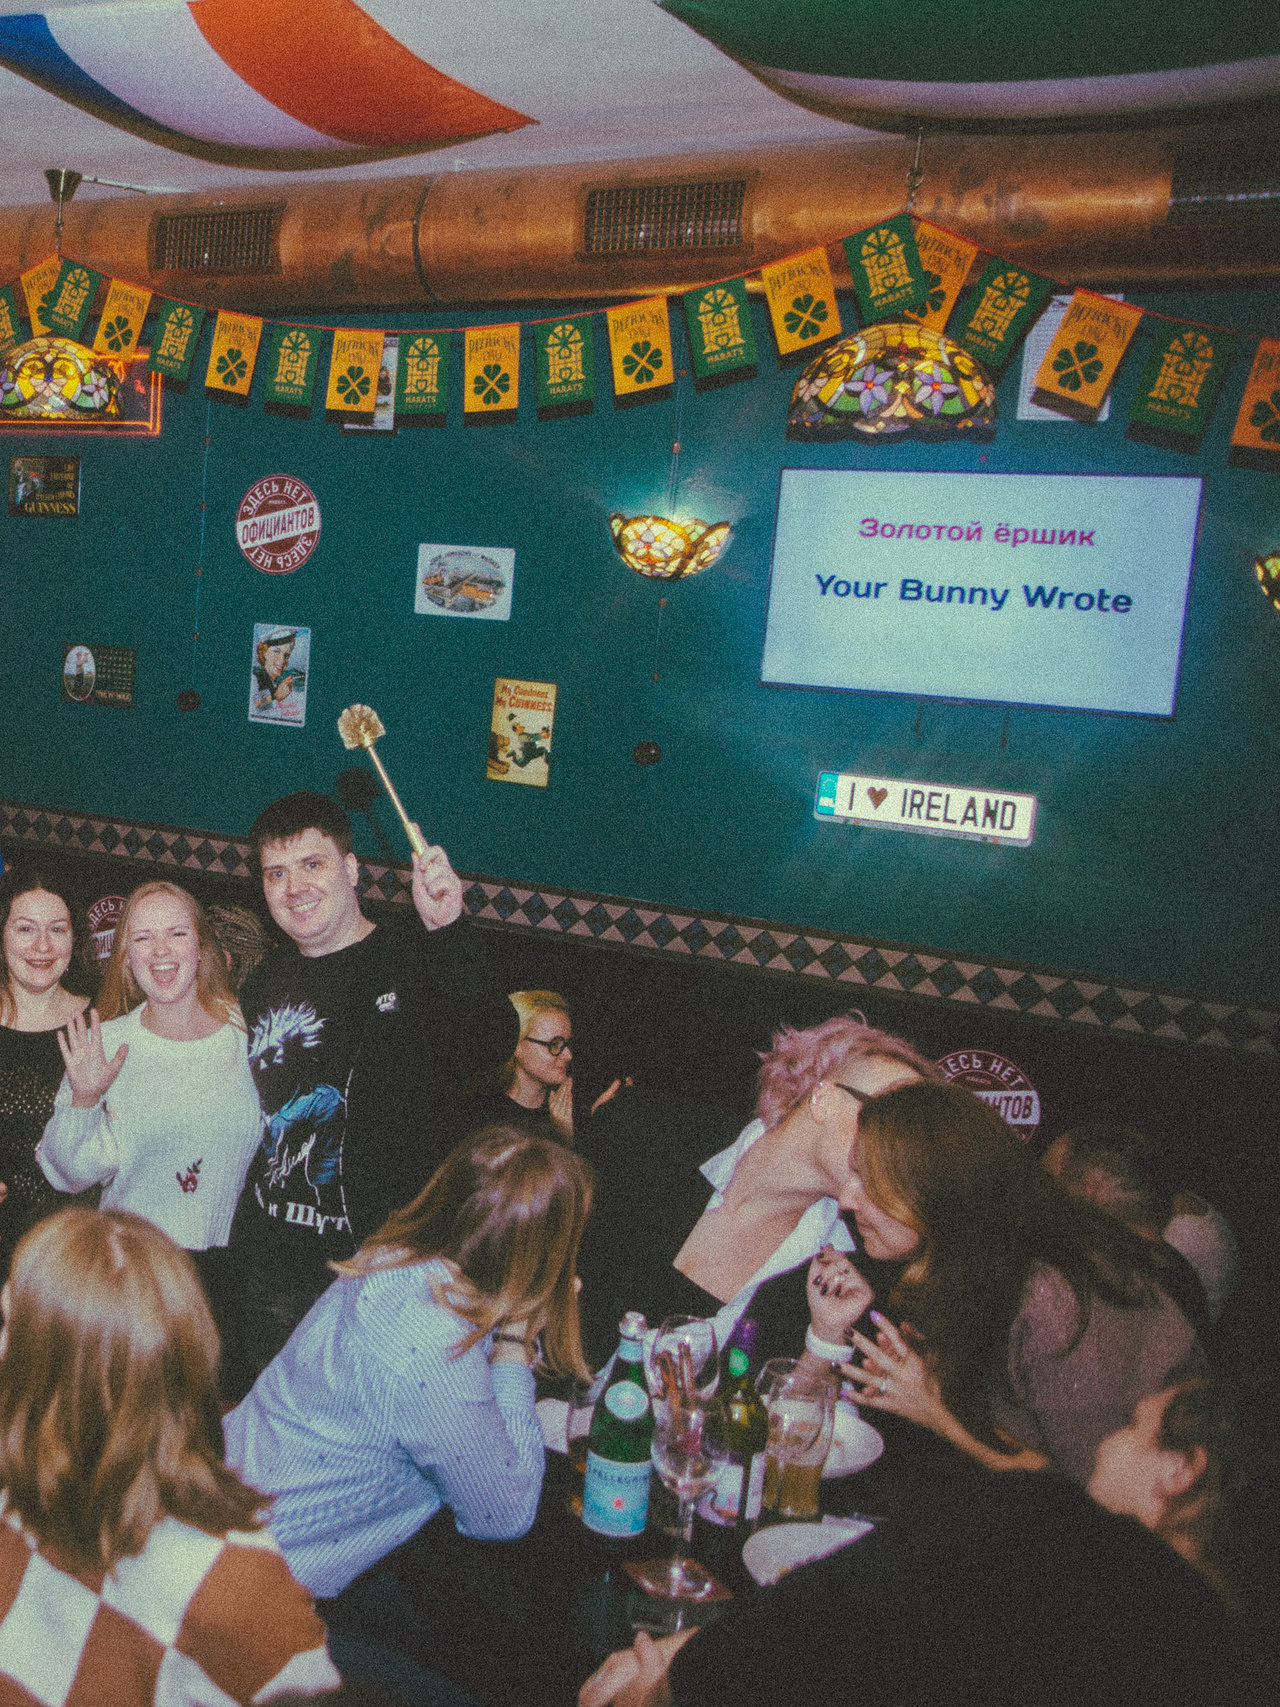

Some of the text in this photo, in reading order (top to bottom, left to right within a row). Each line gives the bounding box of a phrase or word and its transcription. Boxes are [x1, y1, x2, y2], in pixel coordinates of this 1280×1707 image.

[24, 502, 76, 514] GUINNESS
[243, 481, 307, 516] ЗДЕСЬ НЕТ
[242, 507, 314, 544] ОФИЦИАНТОВ
[859, 518, 1096, 547] Золотой ёршик
[250, 536, 312, 568] ЗДЕСЬ НЕТ
[815, 574, 1133, 613] Your Bunny Wrote
[848, 783, 1017, 831] I IRELAND
[990, 1059, 1024, 1087] НЕТ
